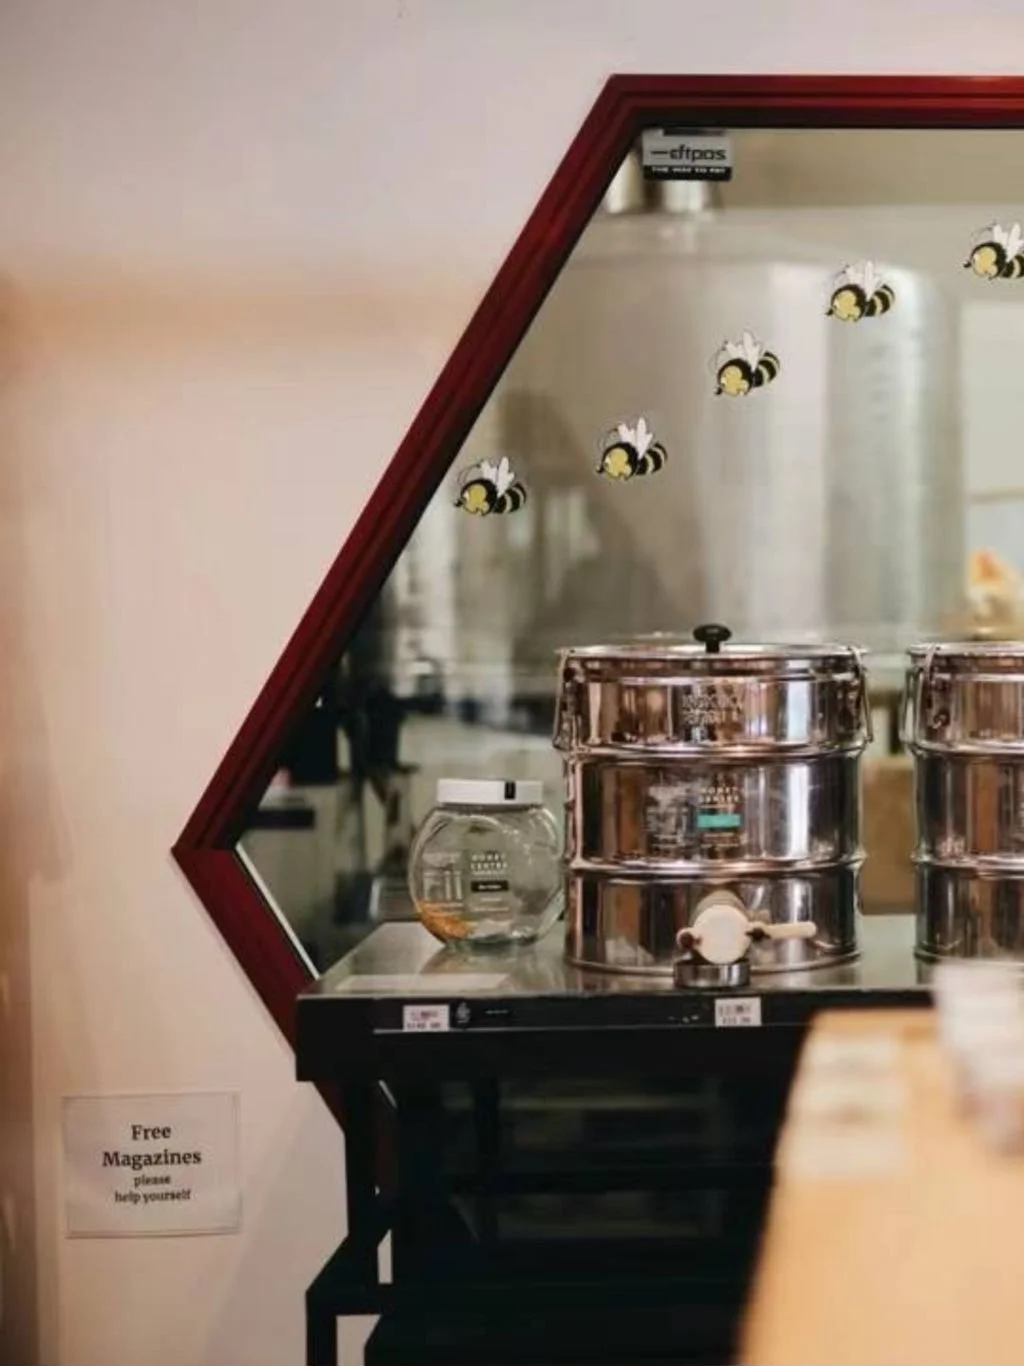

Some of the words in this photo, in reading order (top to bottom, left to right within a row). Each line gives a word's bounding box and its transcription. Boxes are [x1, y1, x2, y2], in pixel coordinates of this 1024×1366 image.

[131, 1124, 172, 1141] Free
[102, 1149, 202, 1170] Magazines
[133, 1174, 171, 1188] please
[115, 1190, 141, 1204] help
[143, 1189, 191, 1205] yourself
